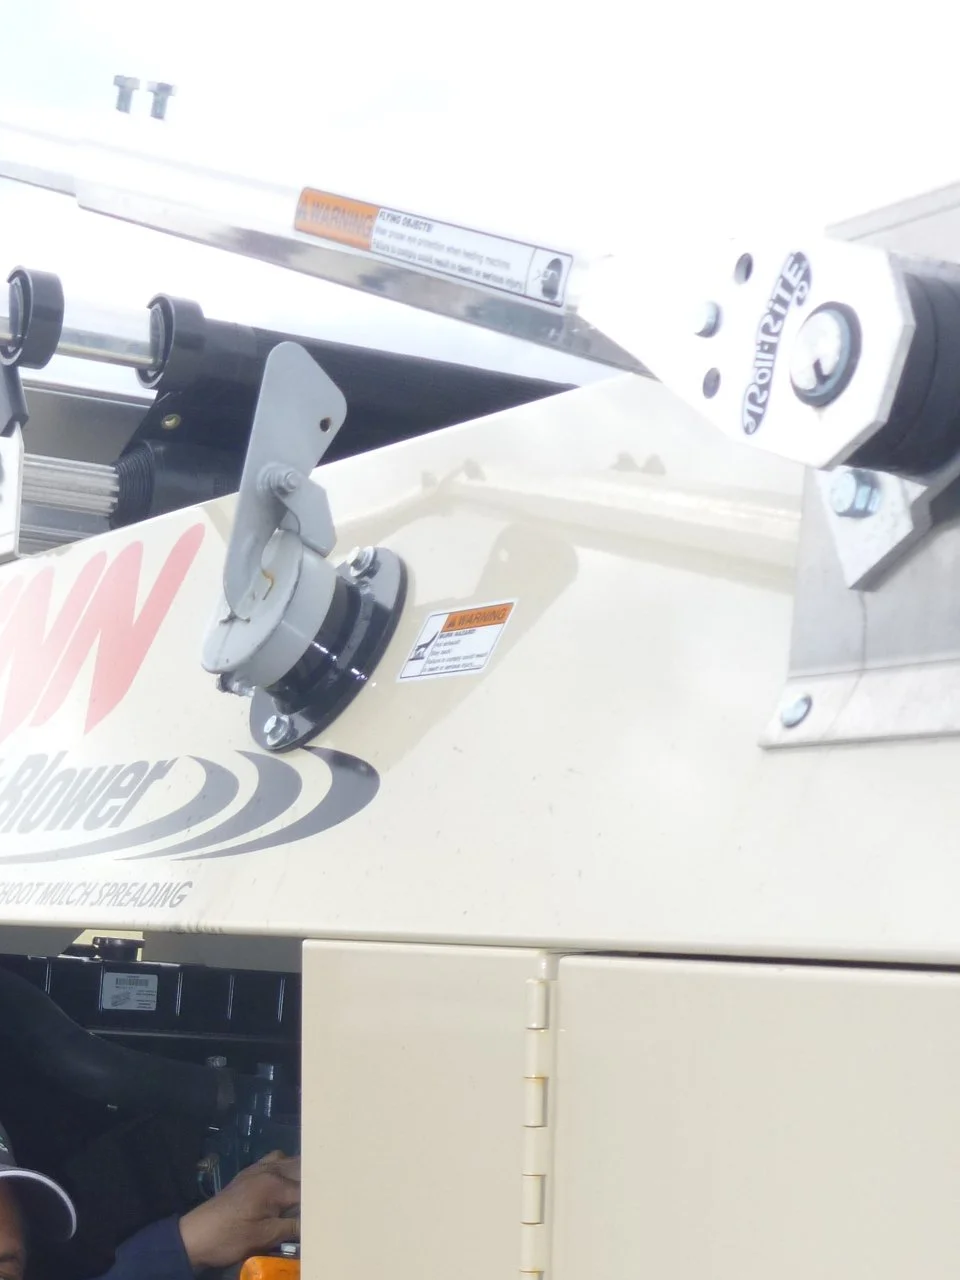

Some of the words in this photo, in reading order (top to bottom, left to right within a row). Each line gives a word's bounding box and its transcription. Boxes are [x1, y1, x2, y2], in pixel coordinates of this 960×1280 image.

[312, 202, 373, 237] WARNING
[37, 881, 93, 907] MULCH
[93, 881, 193, 909] SPREADING
